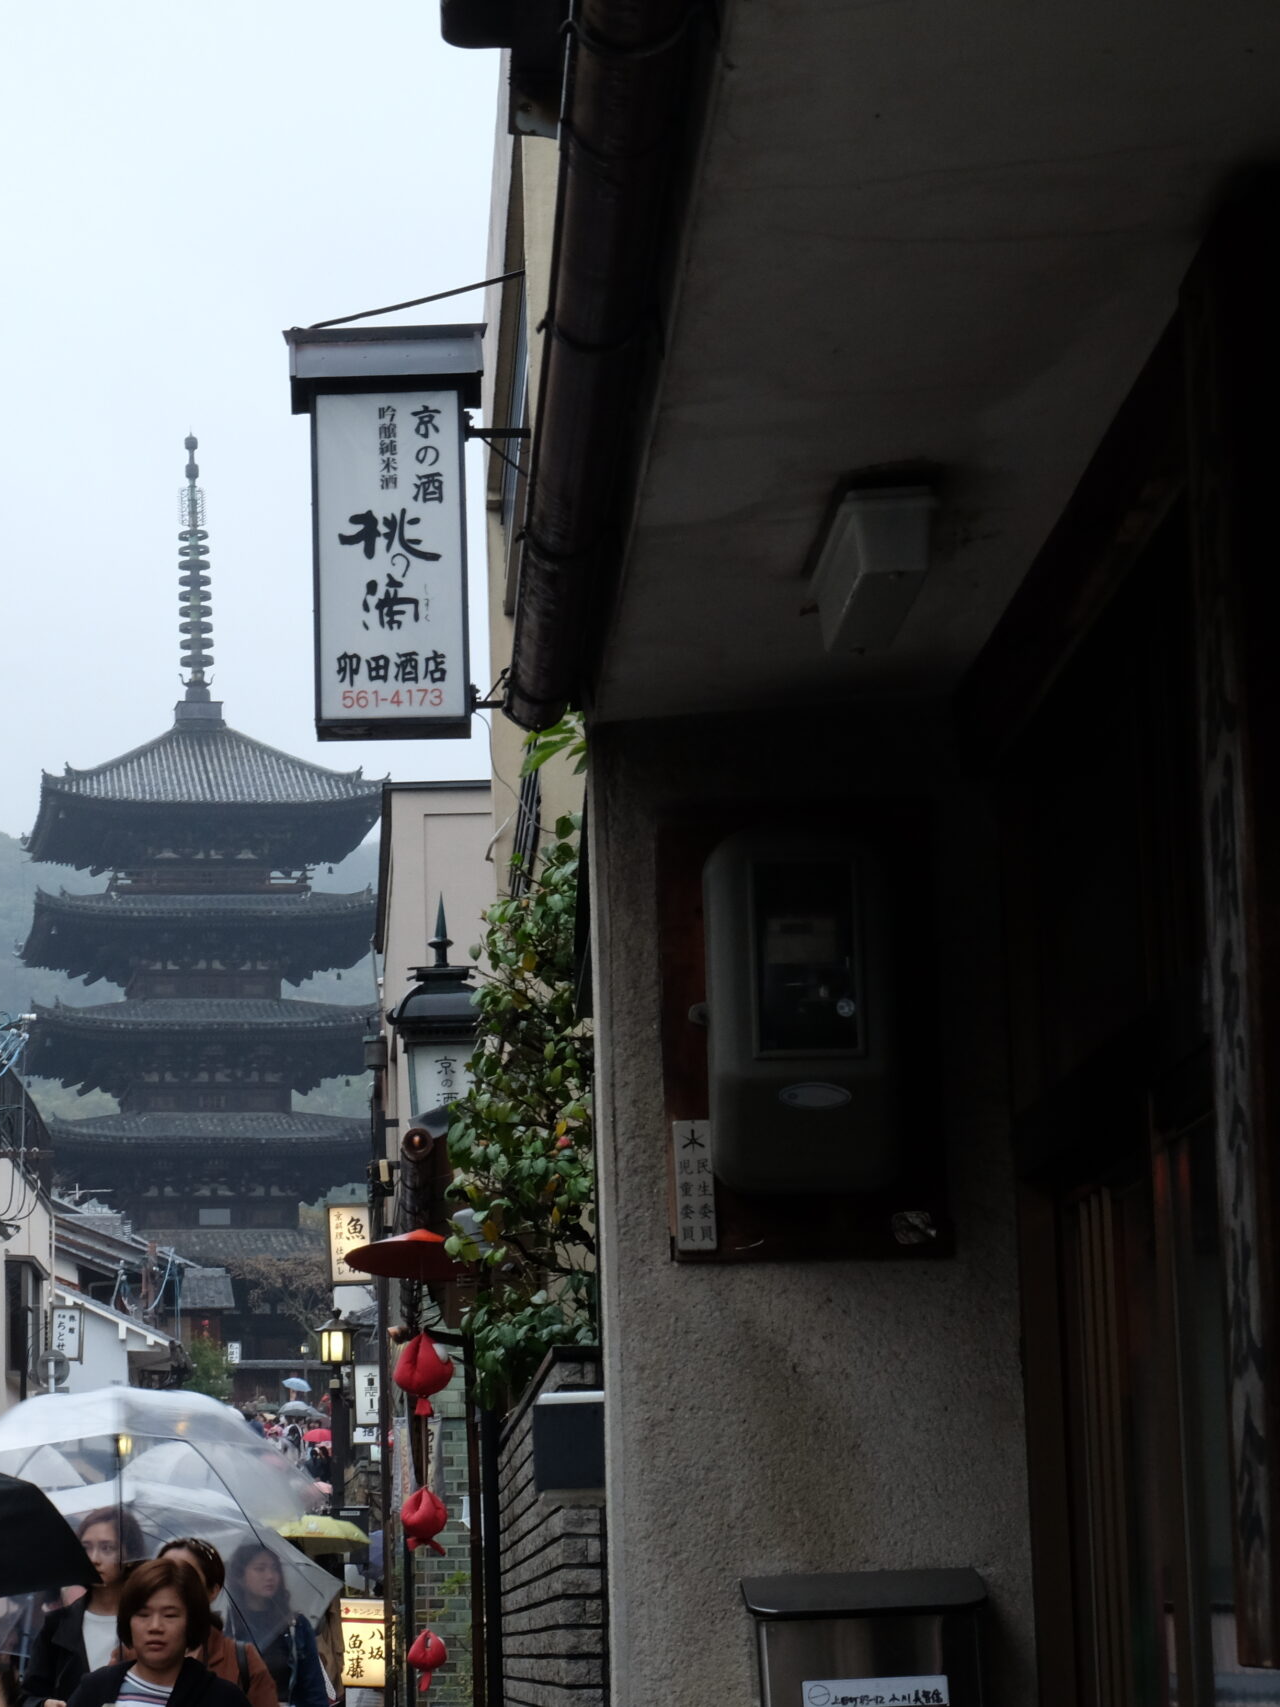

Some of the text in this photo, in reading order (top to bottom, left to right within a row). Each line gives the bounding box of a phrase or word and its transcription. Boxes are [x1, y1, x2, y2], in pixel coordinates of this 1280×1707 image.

[377, 405, 399, 490] 吟醸純米酒
[410, 404, 444, 504] 京の酒
[338, 507, 442, 631] 桃の滴
[336, 649, 448, 687] 卯田酒店
[342, 688, 444, 709] 561-4173
[678, 1159, 696, 1242] 児童委員
[696, 1158, 714, 1242] 民生委員
[352, 1608, 383, 1616] キンシ正
[345, 1633, 366, 1679] 魚藤
[368, 1629, 386, 1661] 八坂
